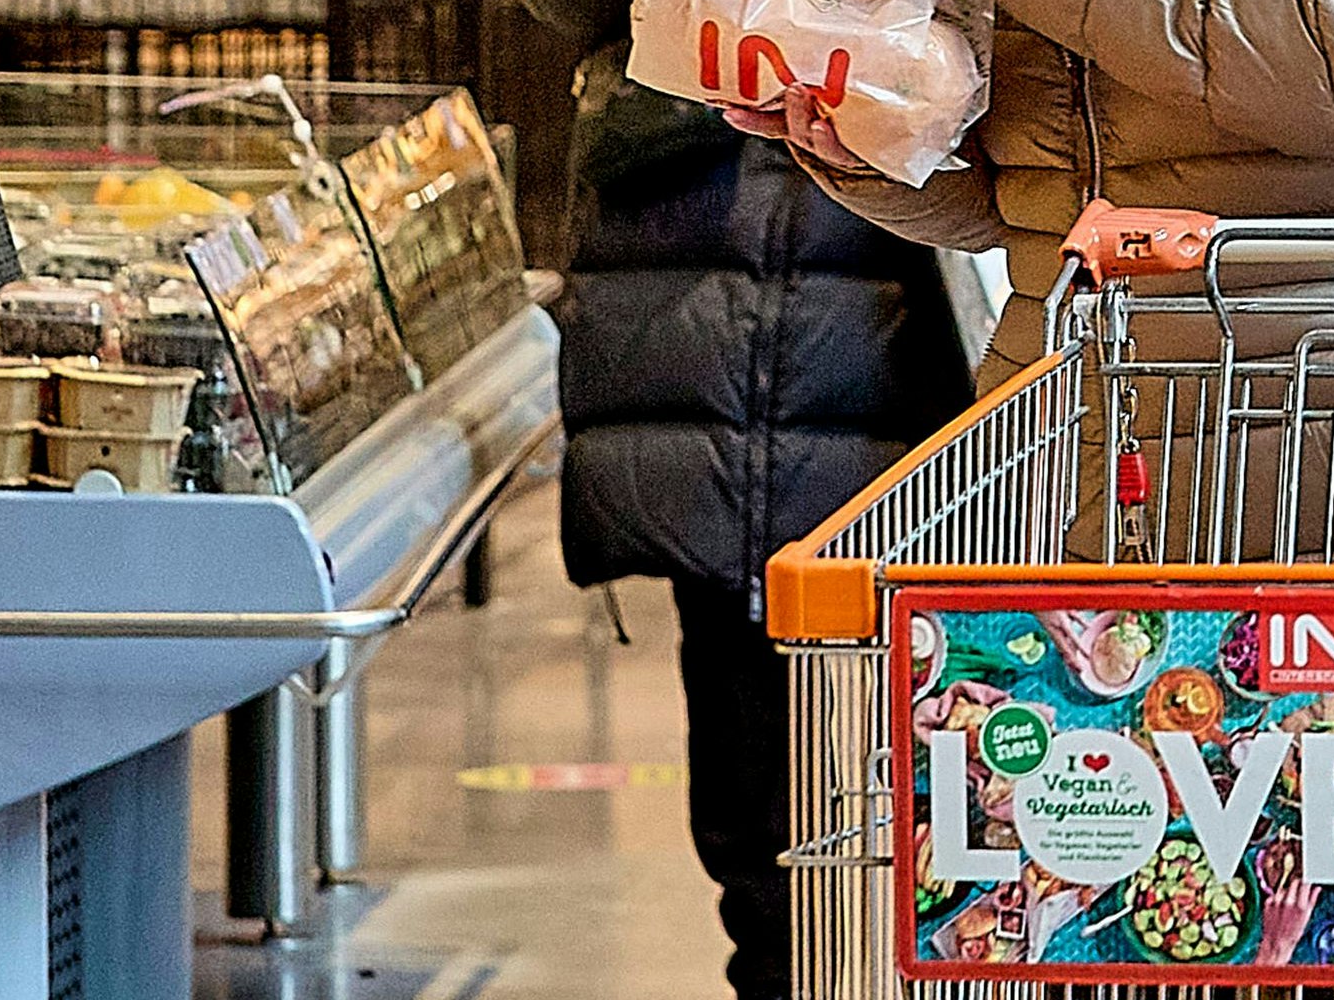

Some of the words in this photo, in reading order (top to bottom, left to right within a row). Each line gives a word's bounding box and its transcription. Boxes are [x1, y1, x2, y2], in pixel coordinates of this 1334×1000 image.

[700, 20, 850, 109] IN
[992, 722, 1036, 744] Jetzt
[995, 738, 1042, 761] neu
[1067, 755, 1077, 772] I
[1043, 774, 1113, 798] Vegan
[1026, 798, 1155, 822] Vegetarisch
